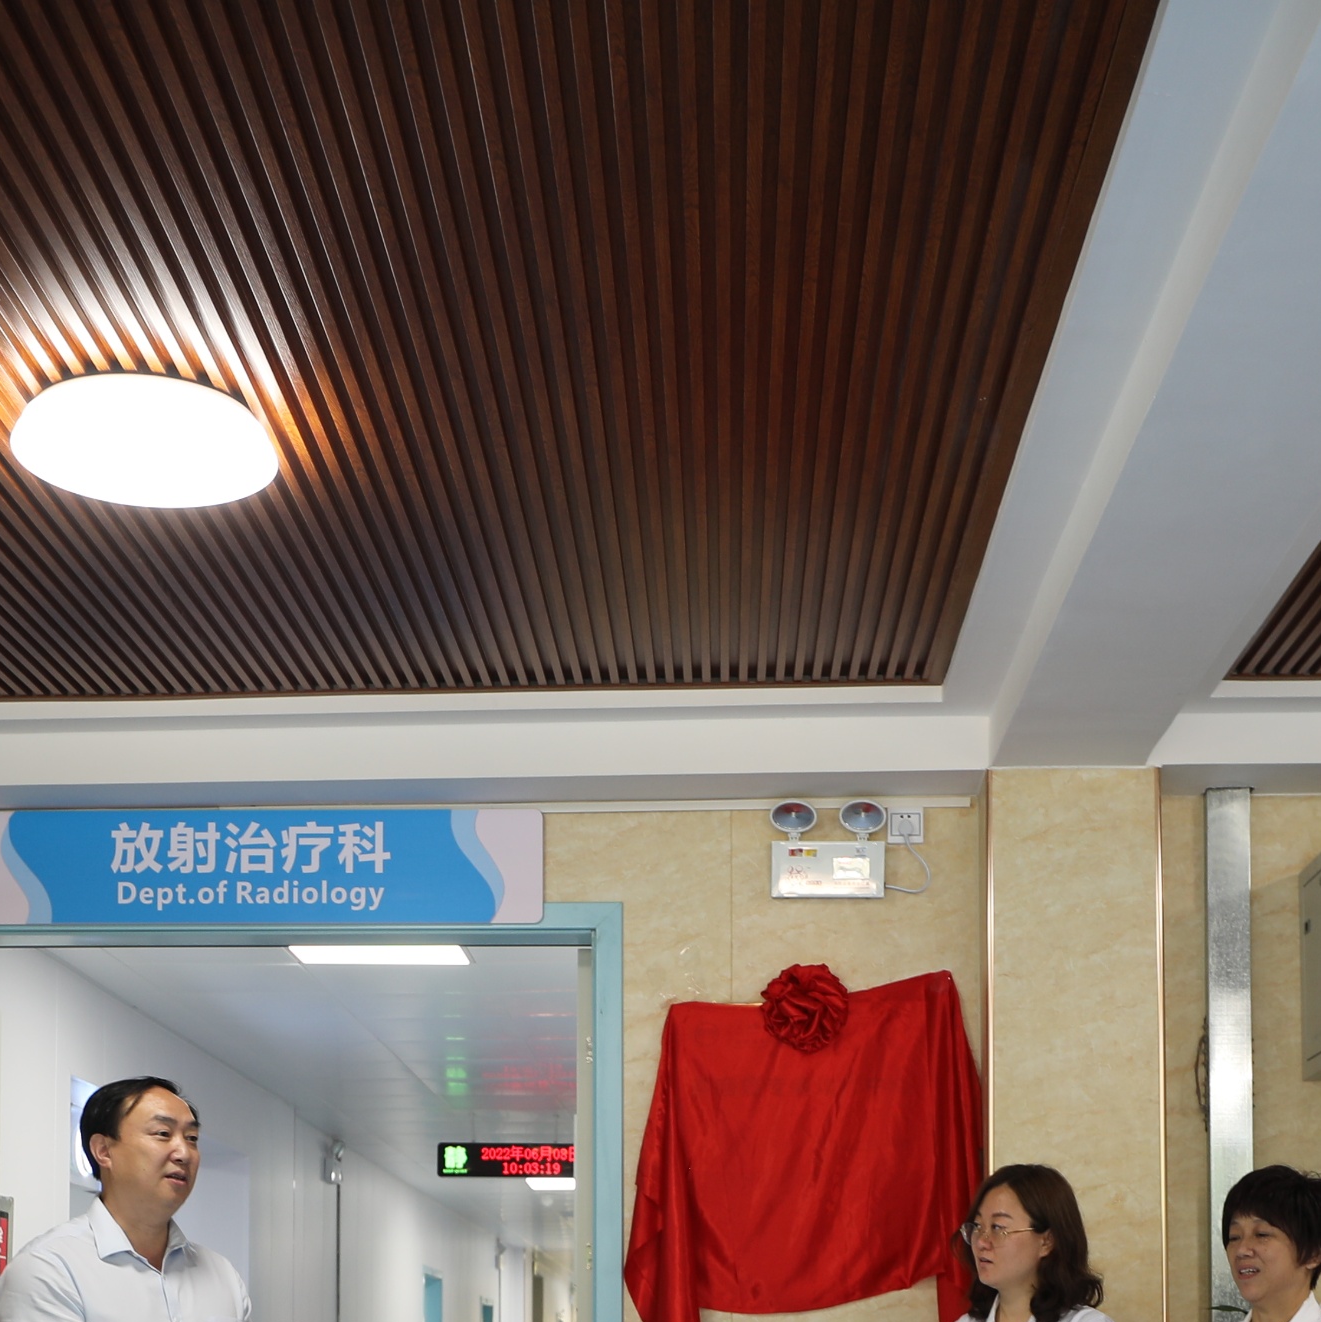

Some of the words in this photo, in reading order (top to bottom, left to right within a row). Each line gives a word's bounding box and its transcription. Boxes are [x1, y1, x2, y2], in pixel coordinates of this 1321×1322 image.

[110, 821, 391, 874] 放射治疗科
[117, 880, 229, 910] Dept.of
[235, 880, 384, 911] Radiology
[502, 1162, 561, 1175] 10:03:19
